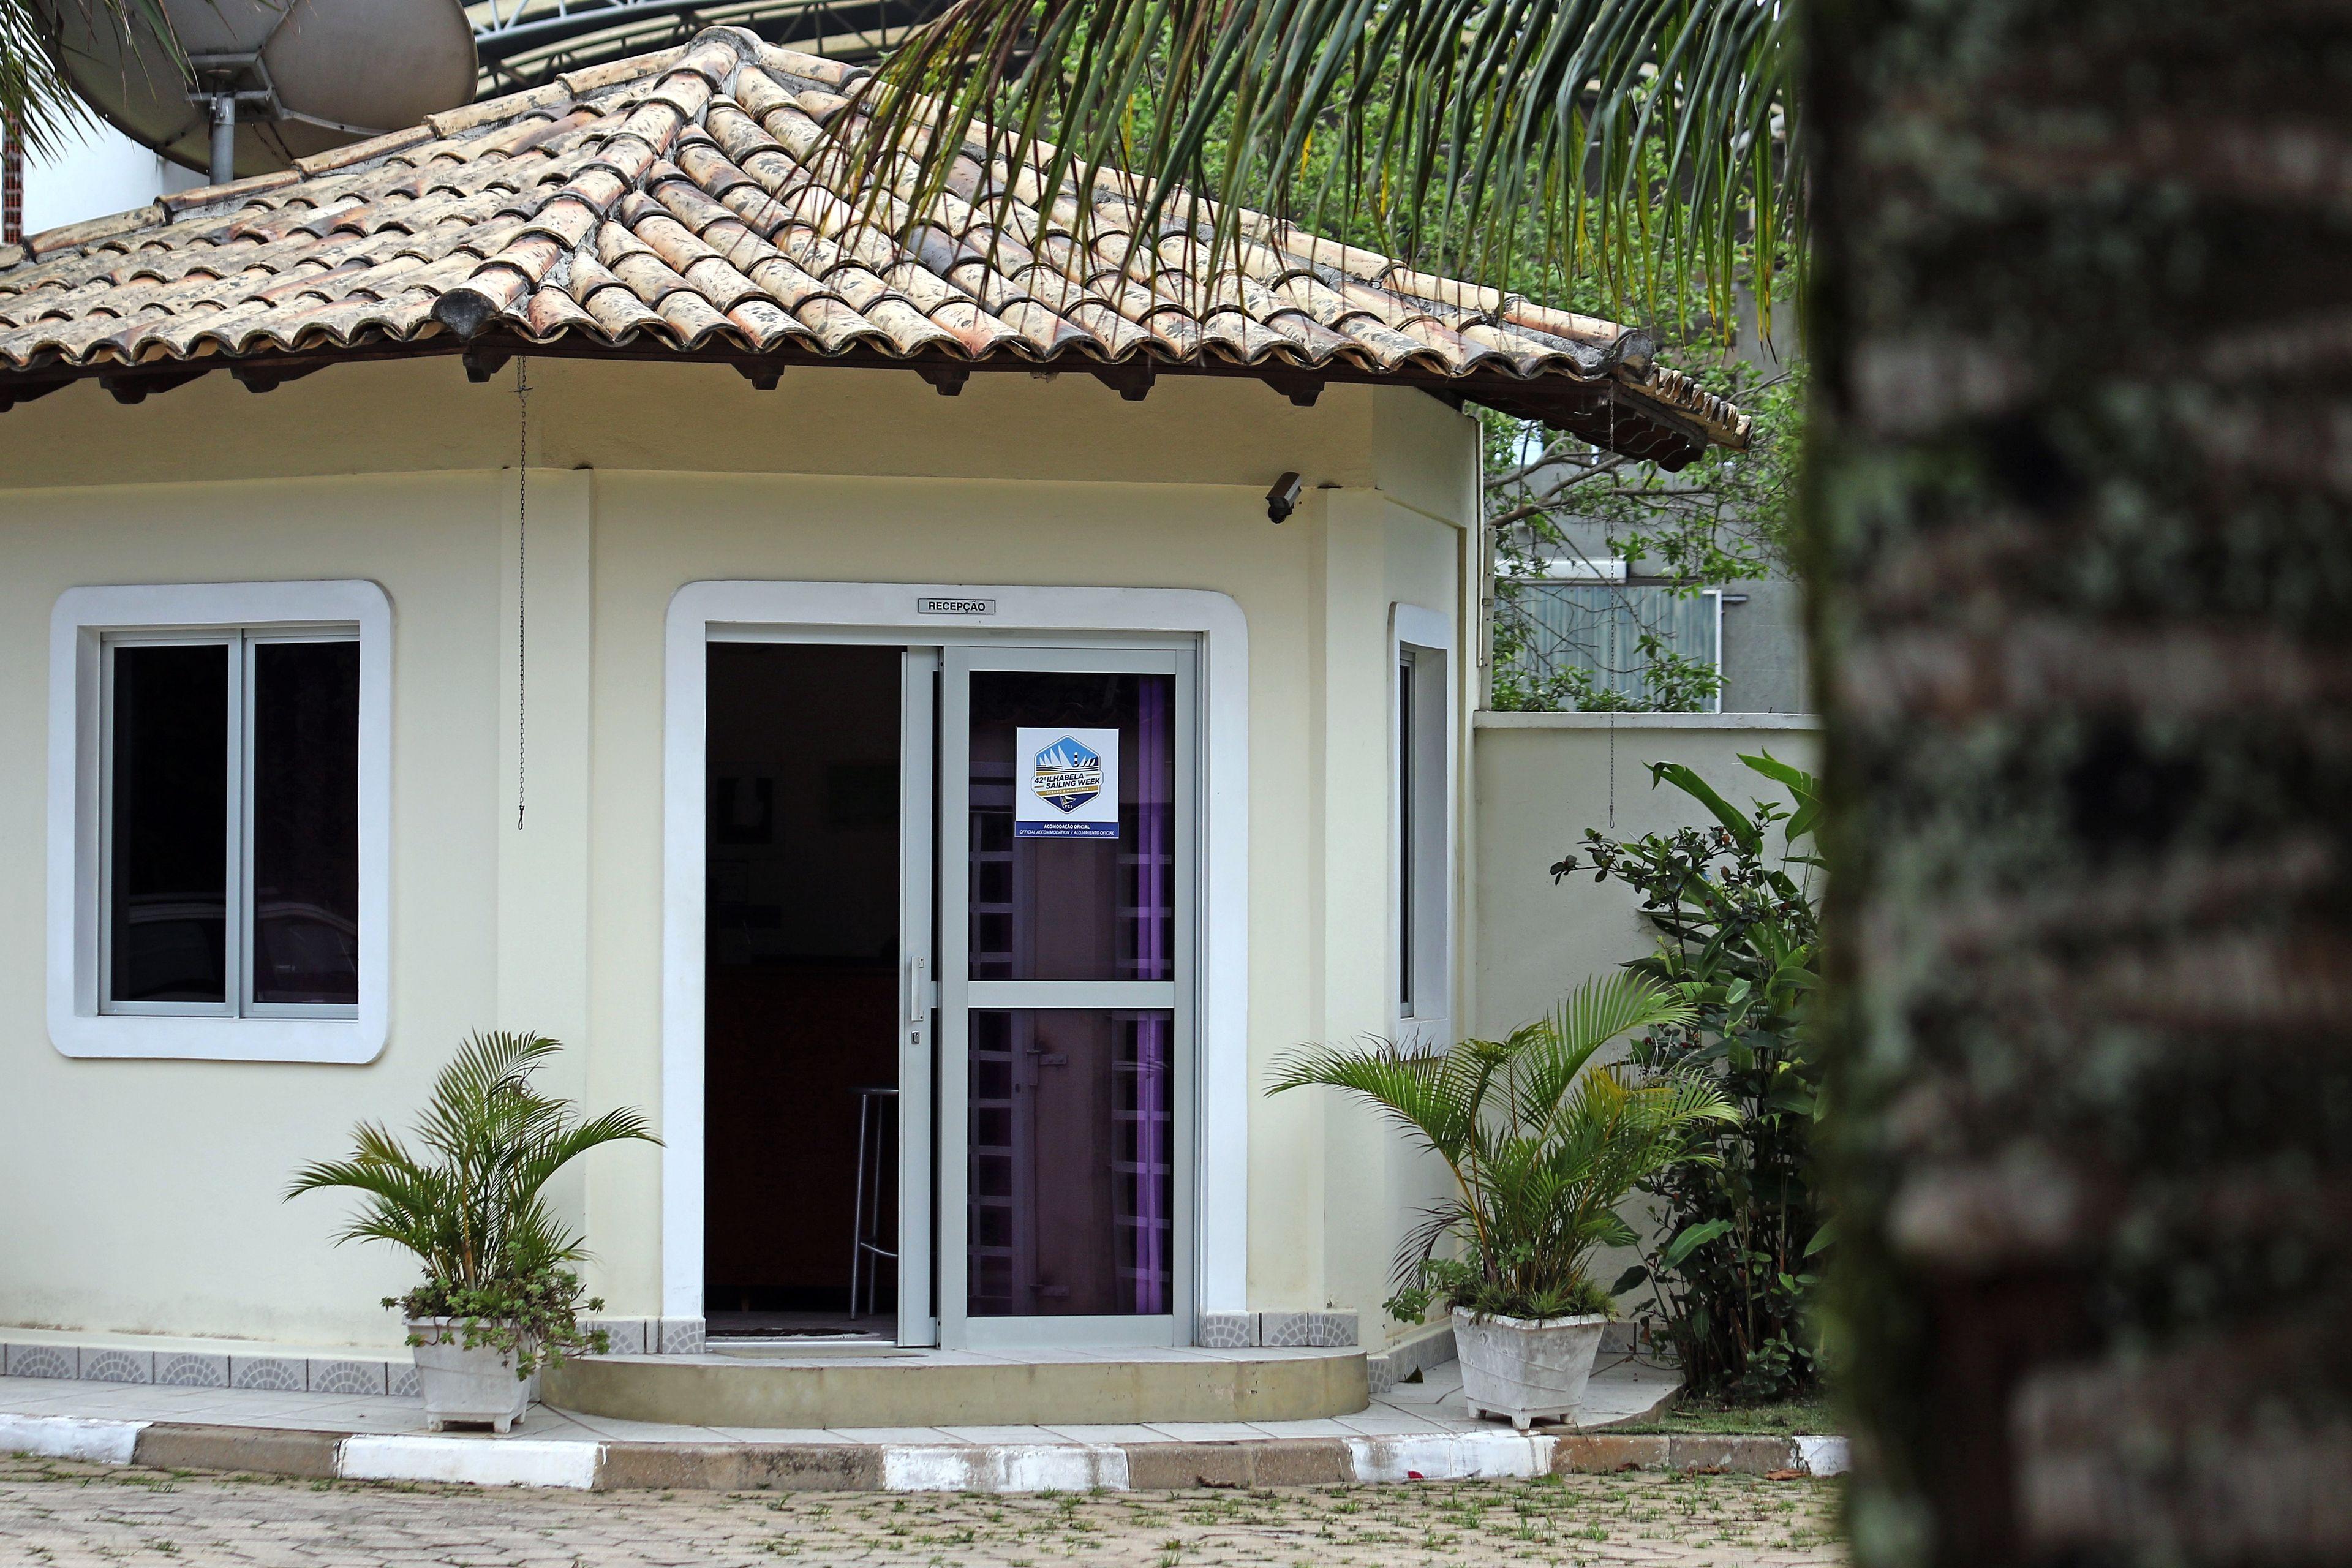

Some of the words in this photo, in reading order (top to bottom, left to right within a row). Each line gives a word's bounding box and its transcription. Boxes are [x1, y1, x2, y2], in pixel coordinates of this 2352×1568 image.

[929, 600, 986, 613] RECEPÇÃO
[1046, 780, 1076, 790] SAILING
[1077, 777, 1101, 786] WEEK
[1047, 772, 1084, 783] ILHABELA
